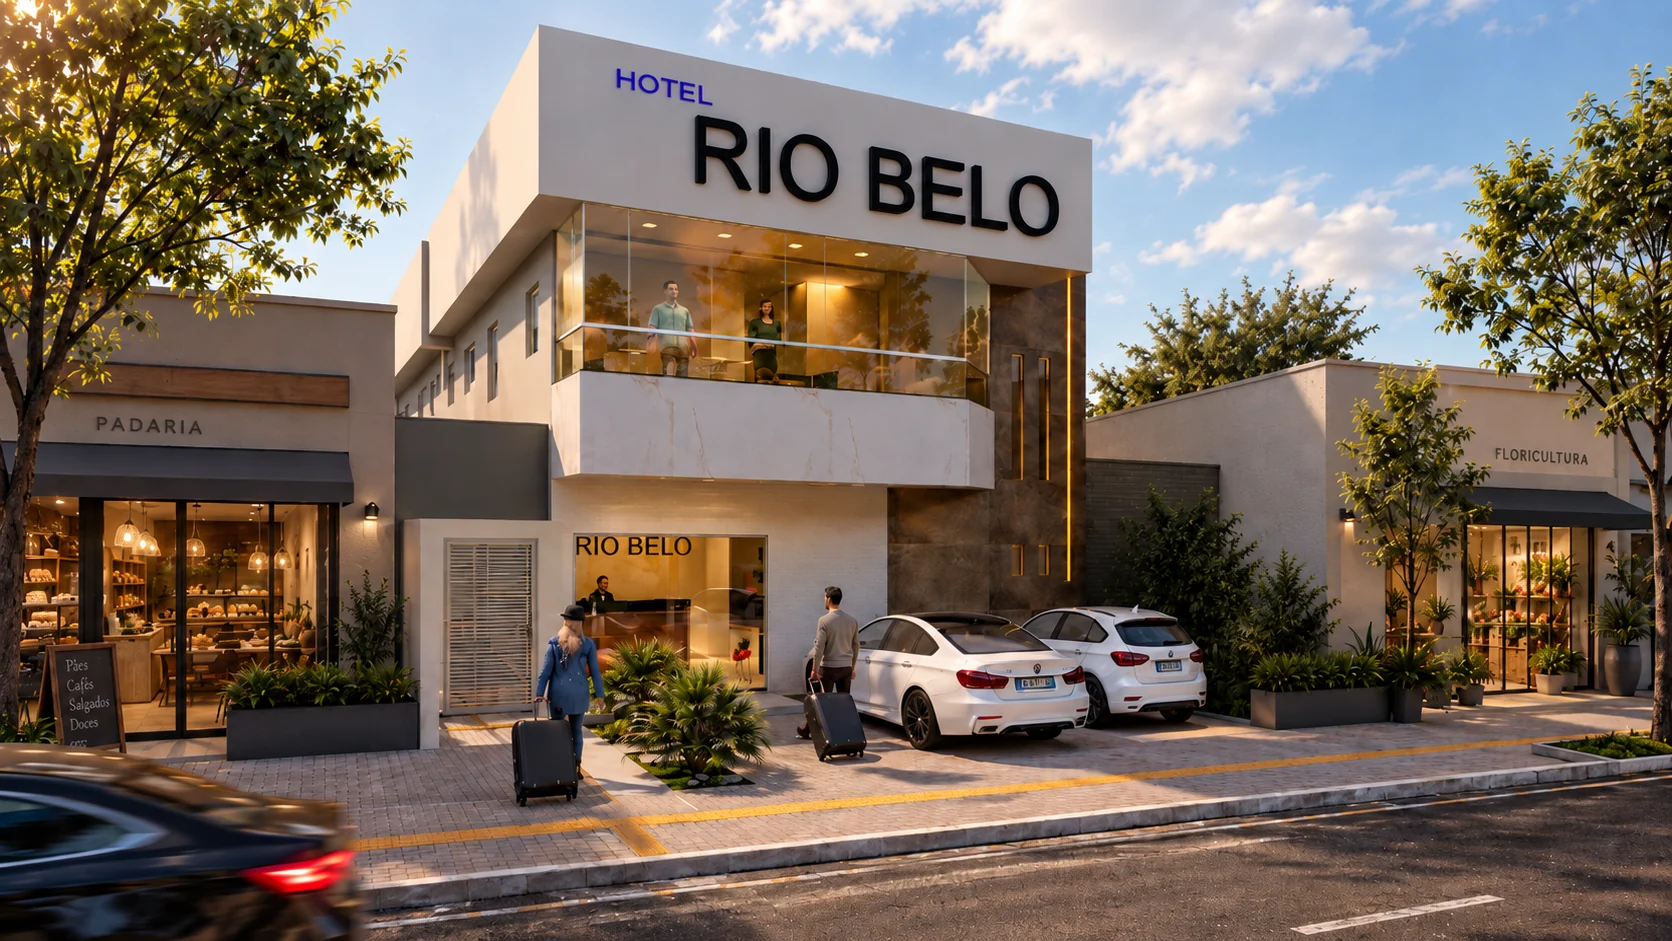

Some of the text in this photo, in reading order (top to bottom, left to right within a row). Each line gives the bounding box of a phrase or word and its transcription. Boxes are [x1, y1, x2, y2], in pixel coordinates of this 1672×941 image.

[615, 68, 713, 105] HOTEL
[694, 115, 1060, 237] RIO BELO
[96, 416, 203, 435] PADARIA
[1495, 447, 1589, 466] FLORICULTURA
[576, 536, 692, 556] RIO BELO
[69, 695, 110, 714] Salgados
[70, 718, 99, 731] Doces
